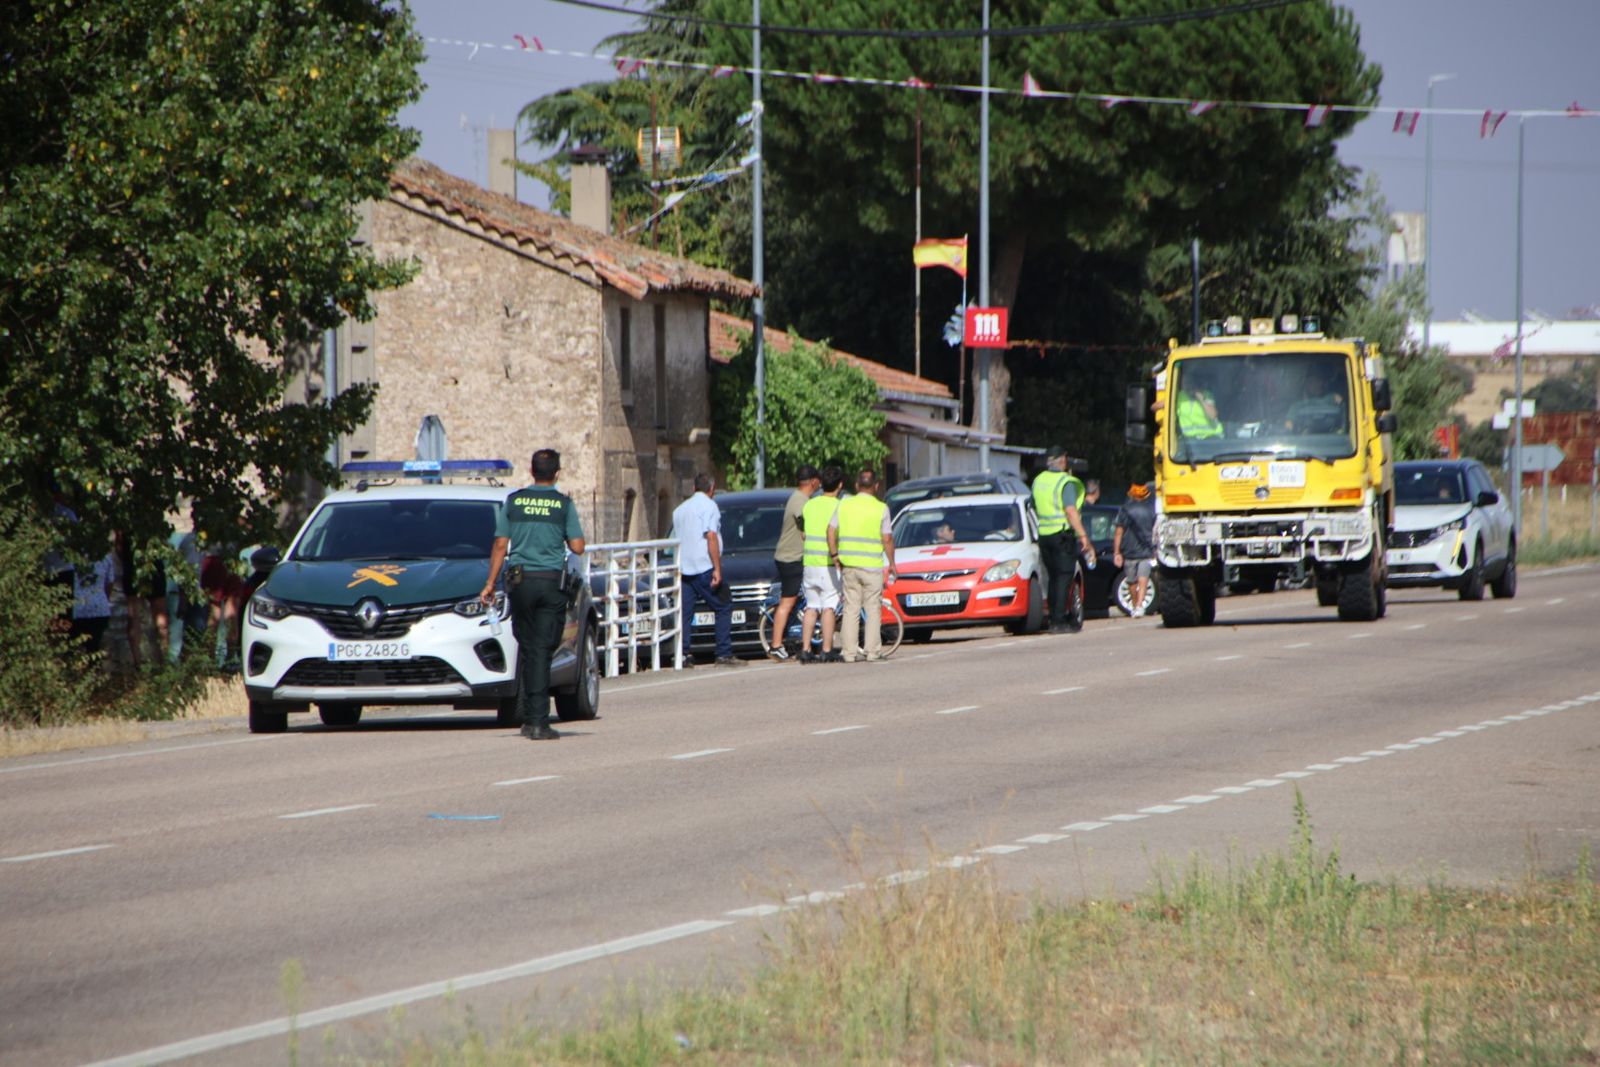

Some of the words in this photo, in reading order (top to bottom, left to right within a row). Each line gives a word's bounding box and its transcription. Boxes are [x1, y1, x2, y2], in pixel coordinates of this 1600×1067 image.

[514, 497, 562, 509] GUARDIA
[524, 506, 551, 516] CIVIL
[336, 644, 362, 657] PGC
[365, 643, 398, 657] 2482
[401, 643, 409, 656] G
